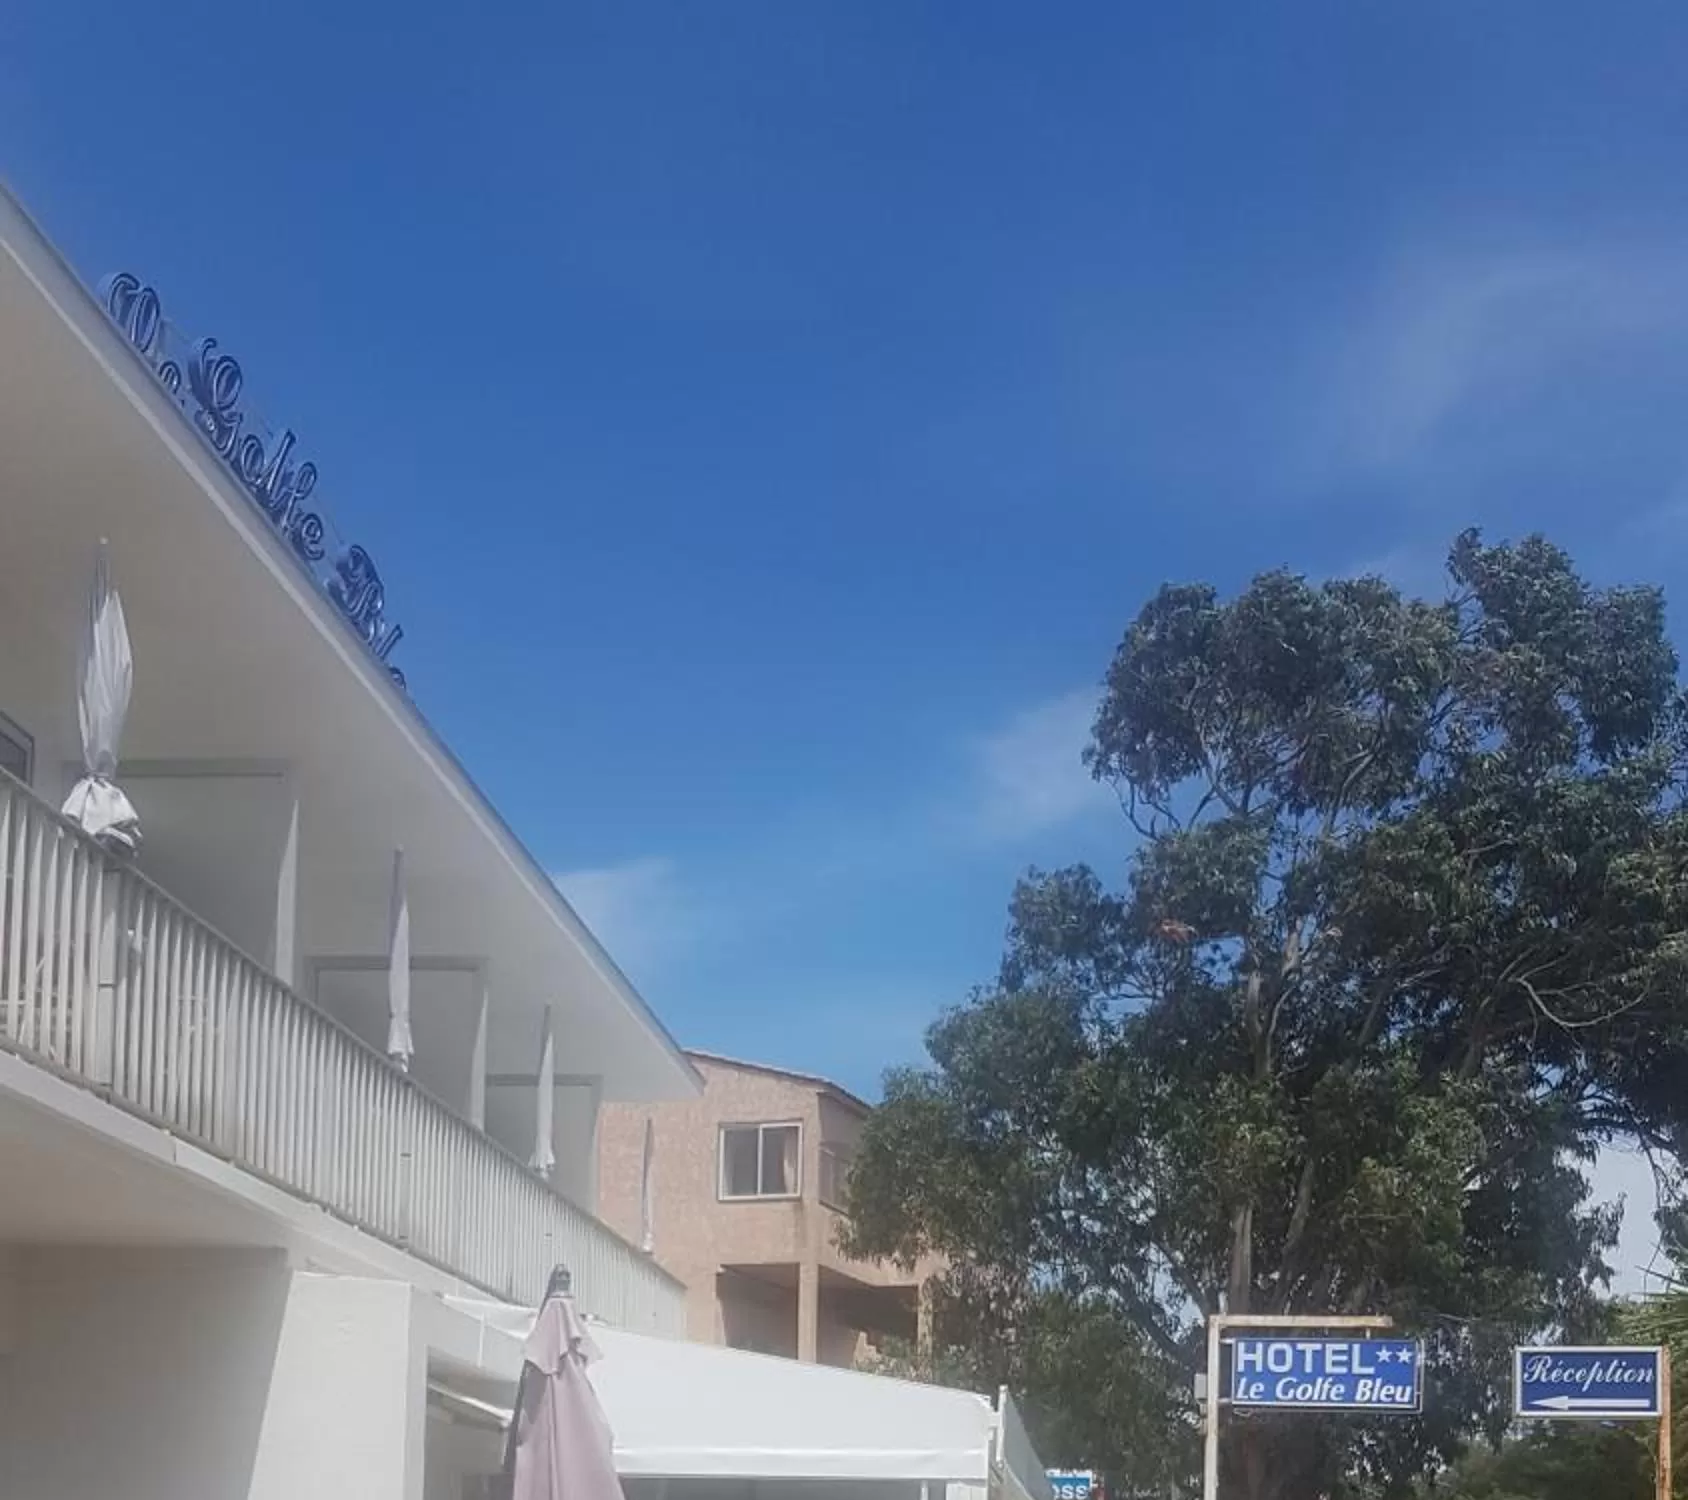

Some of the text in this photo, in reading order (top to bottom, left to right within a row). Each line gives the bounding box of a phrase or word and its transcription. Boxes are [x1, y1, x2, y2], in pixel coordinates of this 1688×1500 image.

[1237, 1341, 1375, 1374] HOTEL
[1523, 1355, 1654, 1392] Réception
[1236, 1376, 1413, 1402] Le Golfe Bleu
